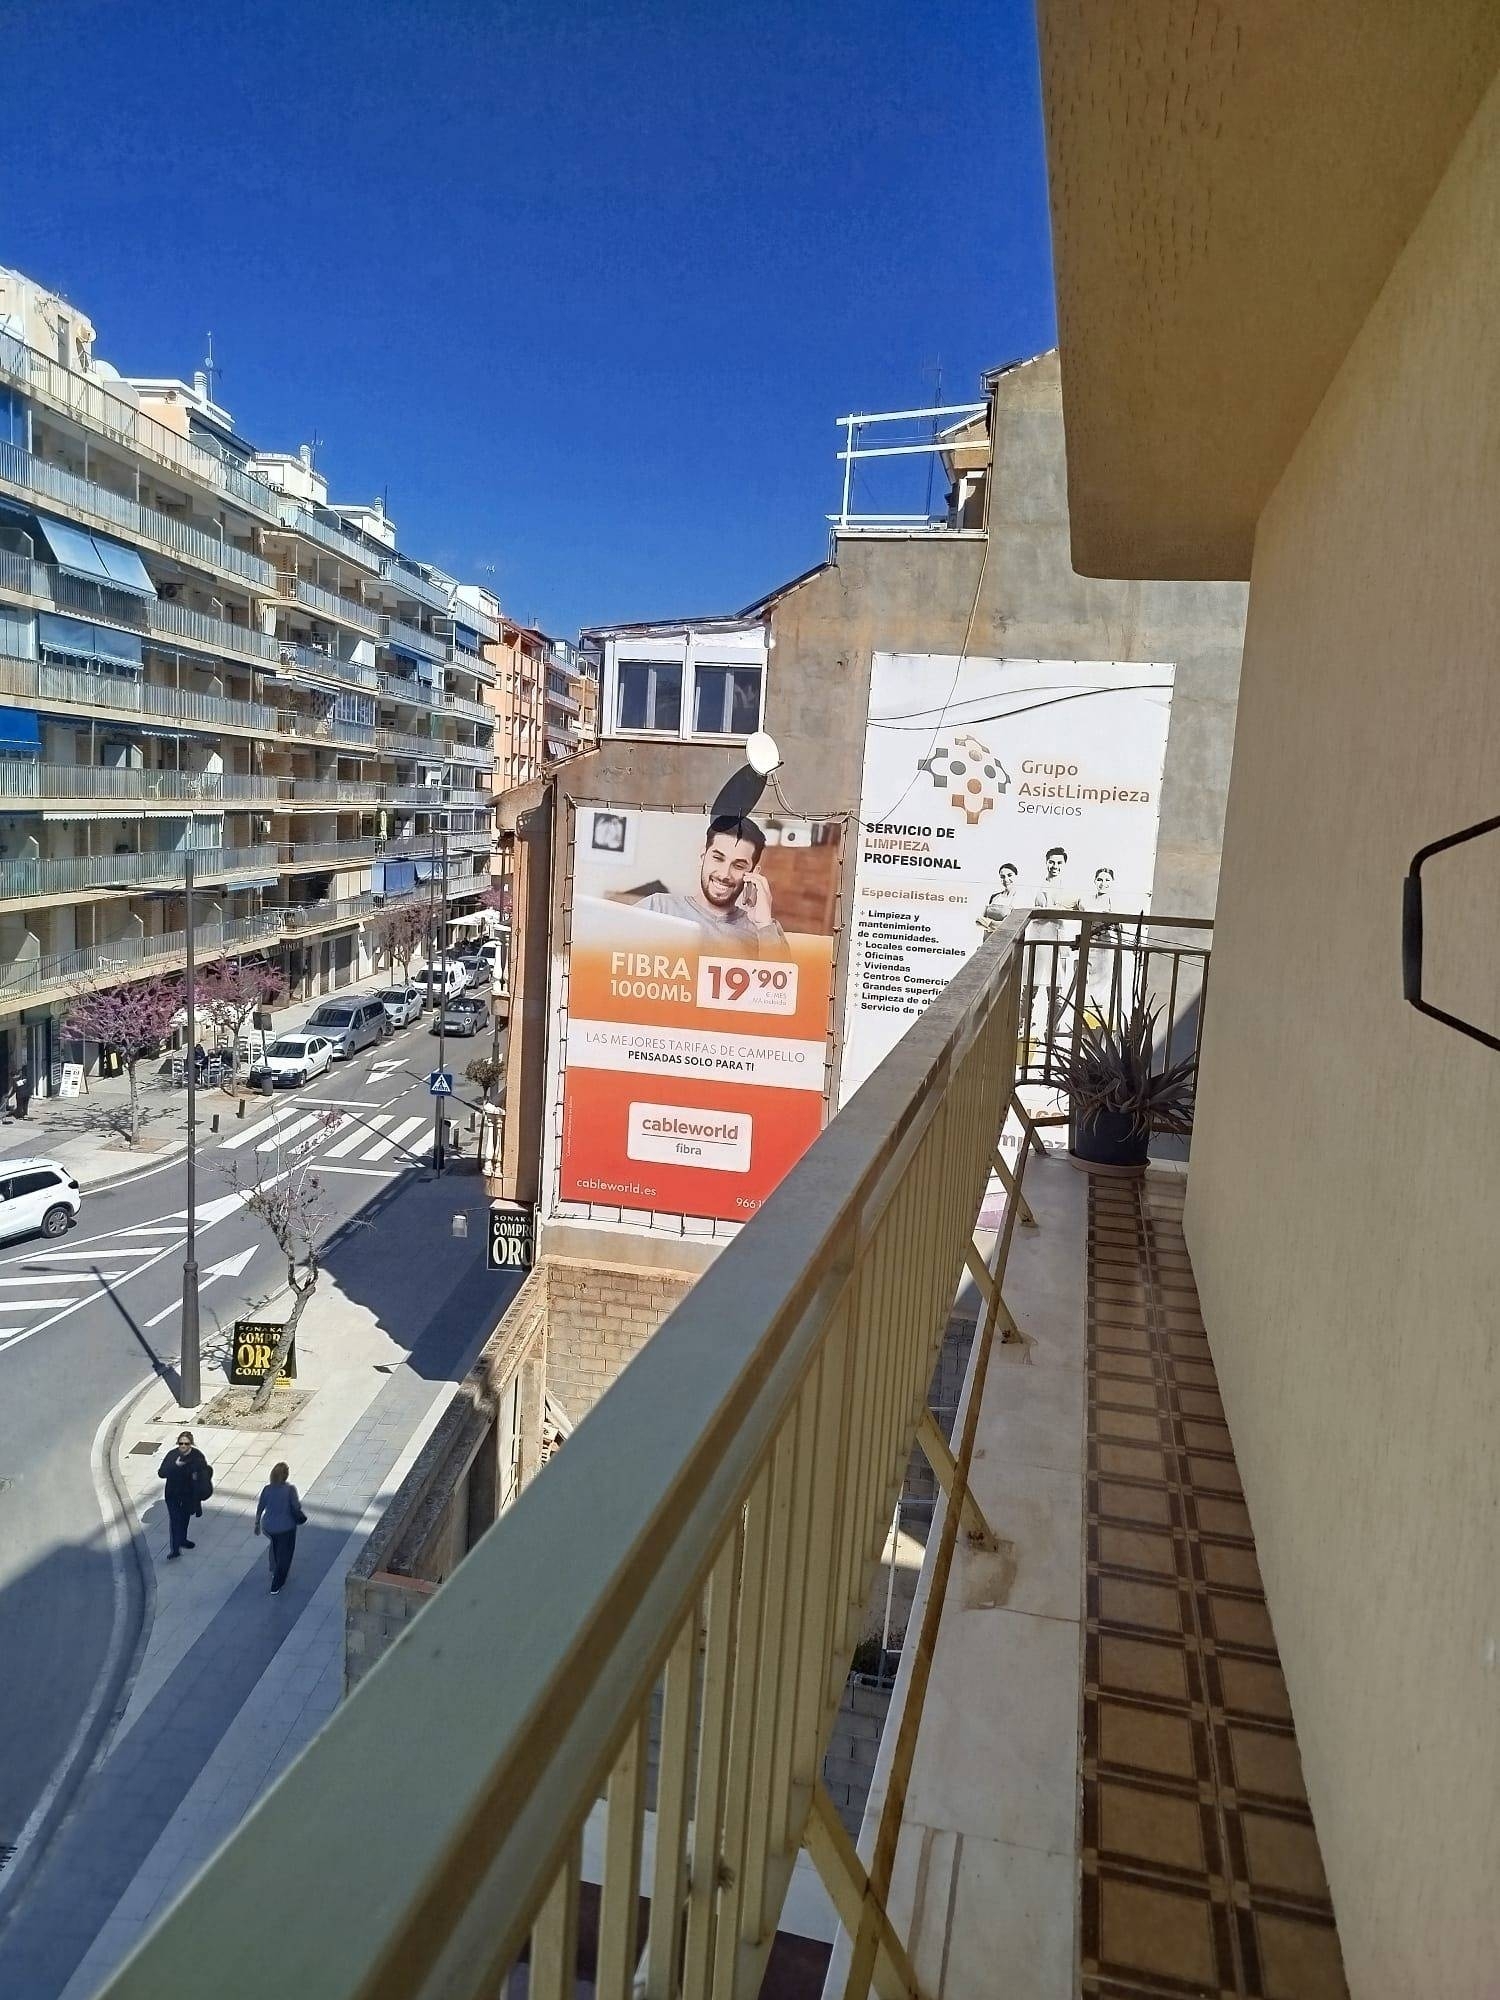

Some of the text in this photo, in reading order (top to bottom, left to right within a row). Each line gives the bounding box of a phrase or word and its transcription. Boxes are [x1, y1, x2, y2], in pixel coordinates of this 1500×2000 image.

[1021, 760, 1078, 776] Grupo
[1018, 782, 1150, 803] AsistLimpieza
[1017, 801, 1082, 817] Servicios
[866, 823, 955, 839] SERVICIO DE
[865, 838, 931, 852] LIMPIEZA
[864, 852, 962, 870] PROFESIONAL
[861, 887, 968, 904] Especialistas en:
[868, 910, 920, 922] Limpieza y
[858, 920, 931, 932] mantenimiento
[857, 930, 939, 944] de comunidades.
[864, 951, 905, 962] Oficinas
[865, 941, 966, 957] Locales comerciales
[611, 951, 691, 981] FIBRA
[864, 961, 911, 973] Viviendas
[863, 971, 901, 982] Centros
[610, 979, 692, 1003] 1000Mb
[862, 982, 903, 993] Grandes
[861, 991, 905, 1003] Limpieza
[907, 996, 920, 1004] de
[861, 1002, 901, 1013] Servicio
[903, 1006, 915, 1014] de
[586, 1032, 805, 1063] LAS MEJORES TARIFAS DE CAMPELLO
[628, 1051, 755, 1072] PENSADAS SOLO PARA TI
[642, 1117, 739, 1140] cableworld
[675, 1143, 702, 1156] fibra
[576, 1178, 657, 1197] cableworld.es
[494, 1214, 528, 1222] SONAK
